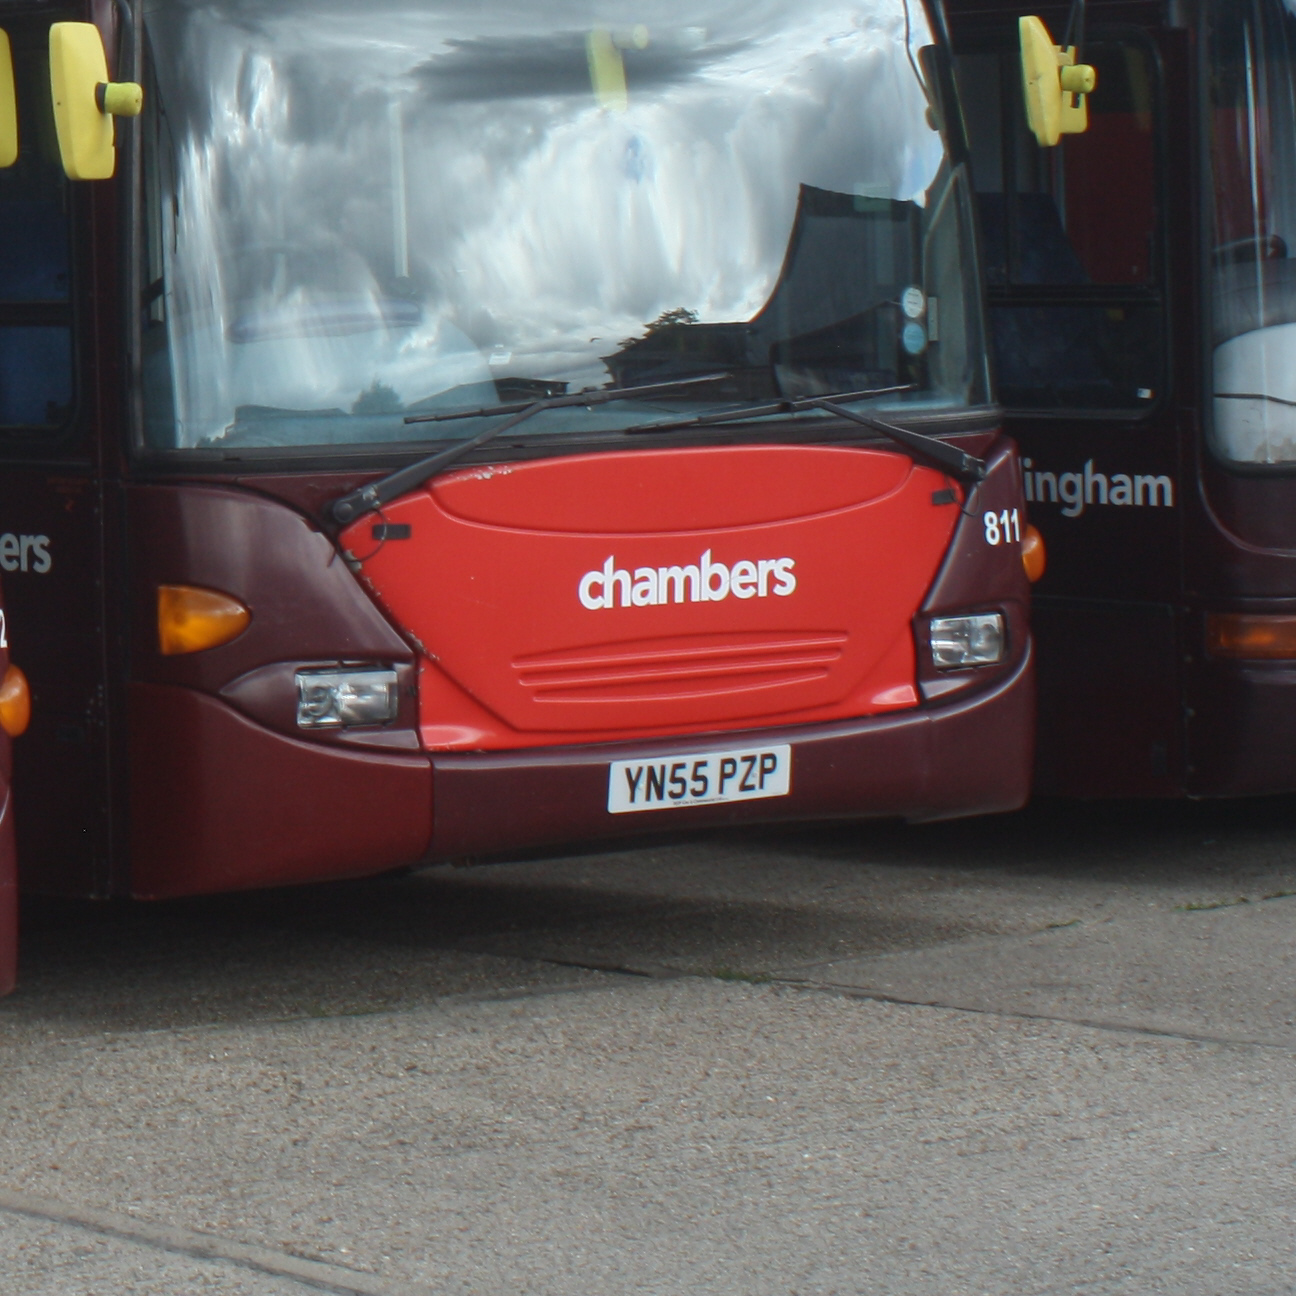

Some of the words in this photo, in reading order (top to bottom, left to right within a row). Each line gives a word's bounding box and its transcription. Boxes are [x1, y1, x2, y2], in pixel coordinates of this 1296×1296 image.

[983, 508, 1020, 546] 811
[578, 549, 797, 610] chambers
[624, 760, 709, 804] YN55
[718, 752, 778, 795] PZP
